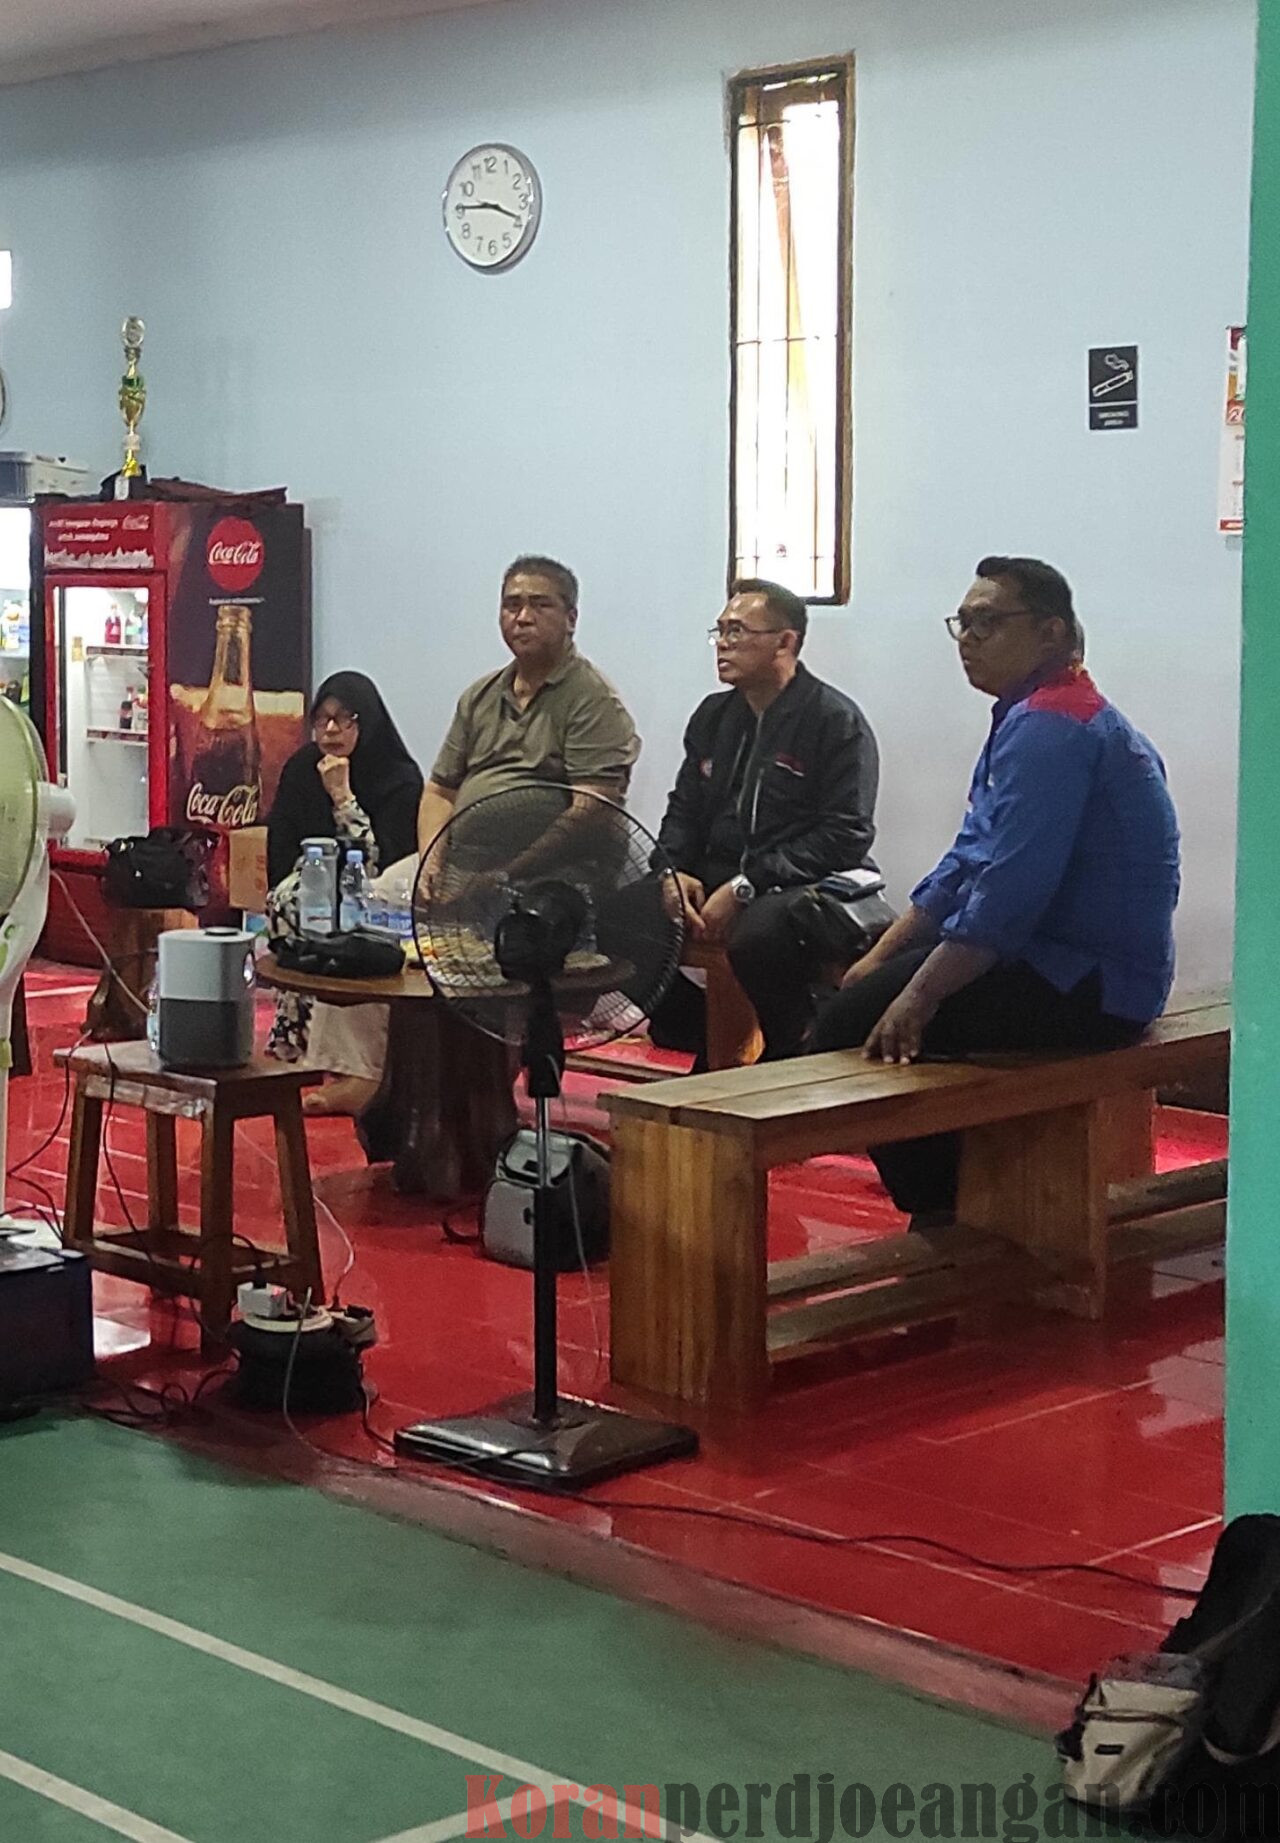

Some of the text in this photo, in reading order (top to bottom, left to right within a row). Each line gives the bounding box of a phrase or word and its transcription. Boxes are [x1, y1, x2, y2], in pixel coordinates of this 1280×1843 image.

[471, 164, 482, 180] 11
[484, 155, 497, 173] 12
[461, 181, 474, 198] 10
[512, 173, 522, 191] 2
[518, 193, 528, 210] 3
[461, 223, 471, 240] 8
[475, 236, 484, 252] 7
[487, 240, 497, 257] 6
[502, 233, 512, 250] 5
